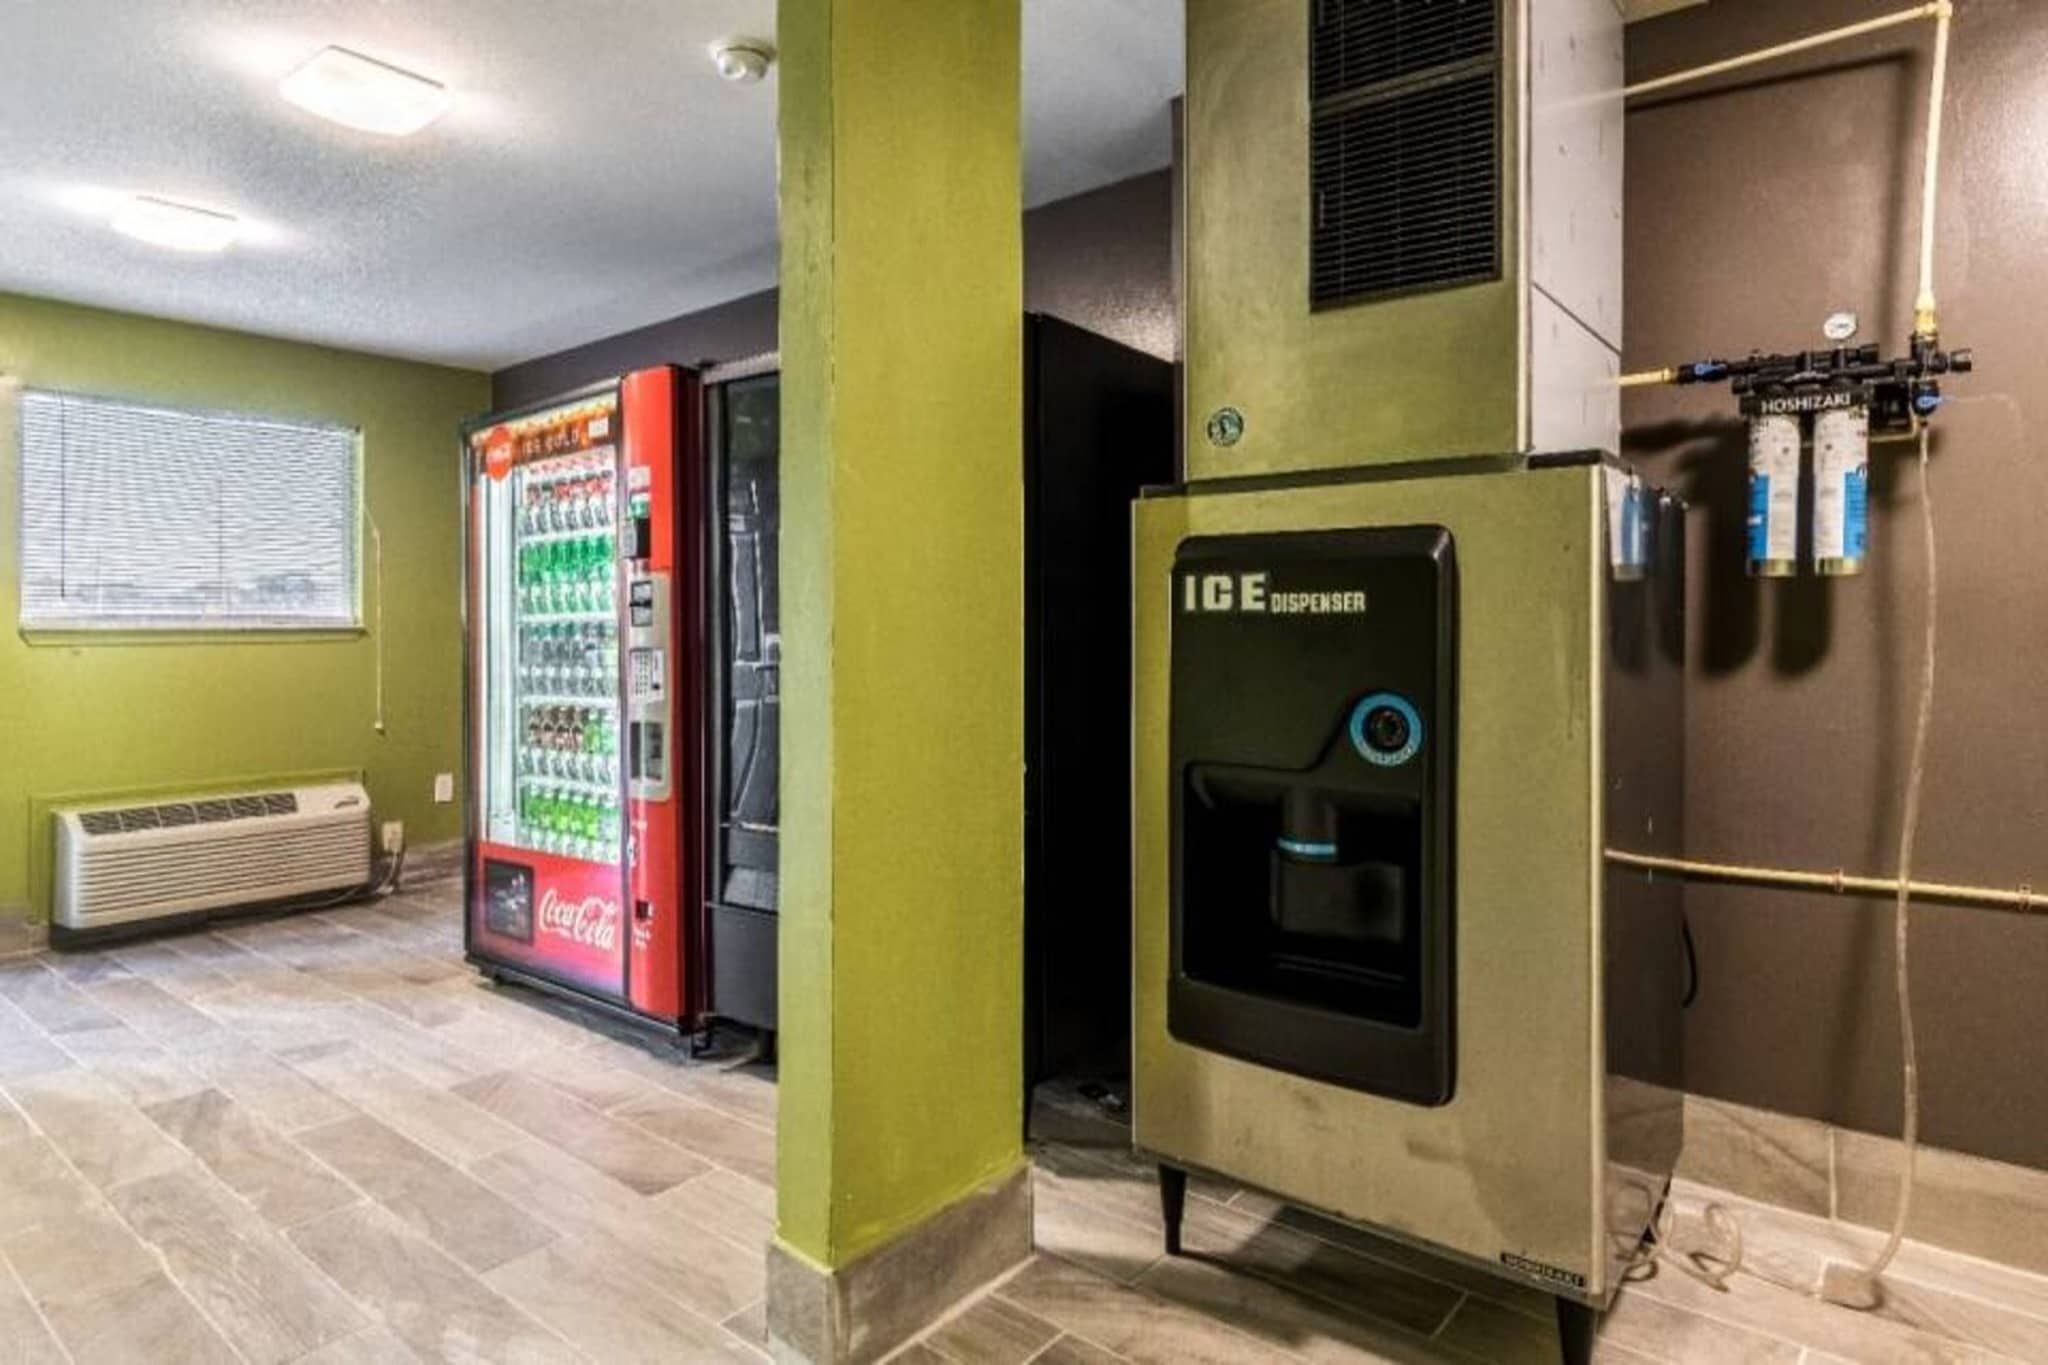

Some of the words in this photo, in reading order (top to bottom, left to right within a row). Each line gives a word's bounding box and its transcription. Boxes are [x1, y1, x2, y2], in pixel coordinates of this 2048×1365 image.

[1761, 391, 1851, 414] HOSHIZAKI
[1185, 573, 1265, 611] ICE
[1271, 592, 1365, 613] DISPENSER
